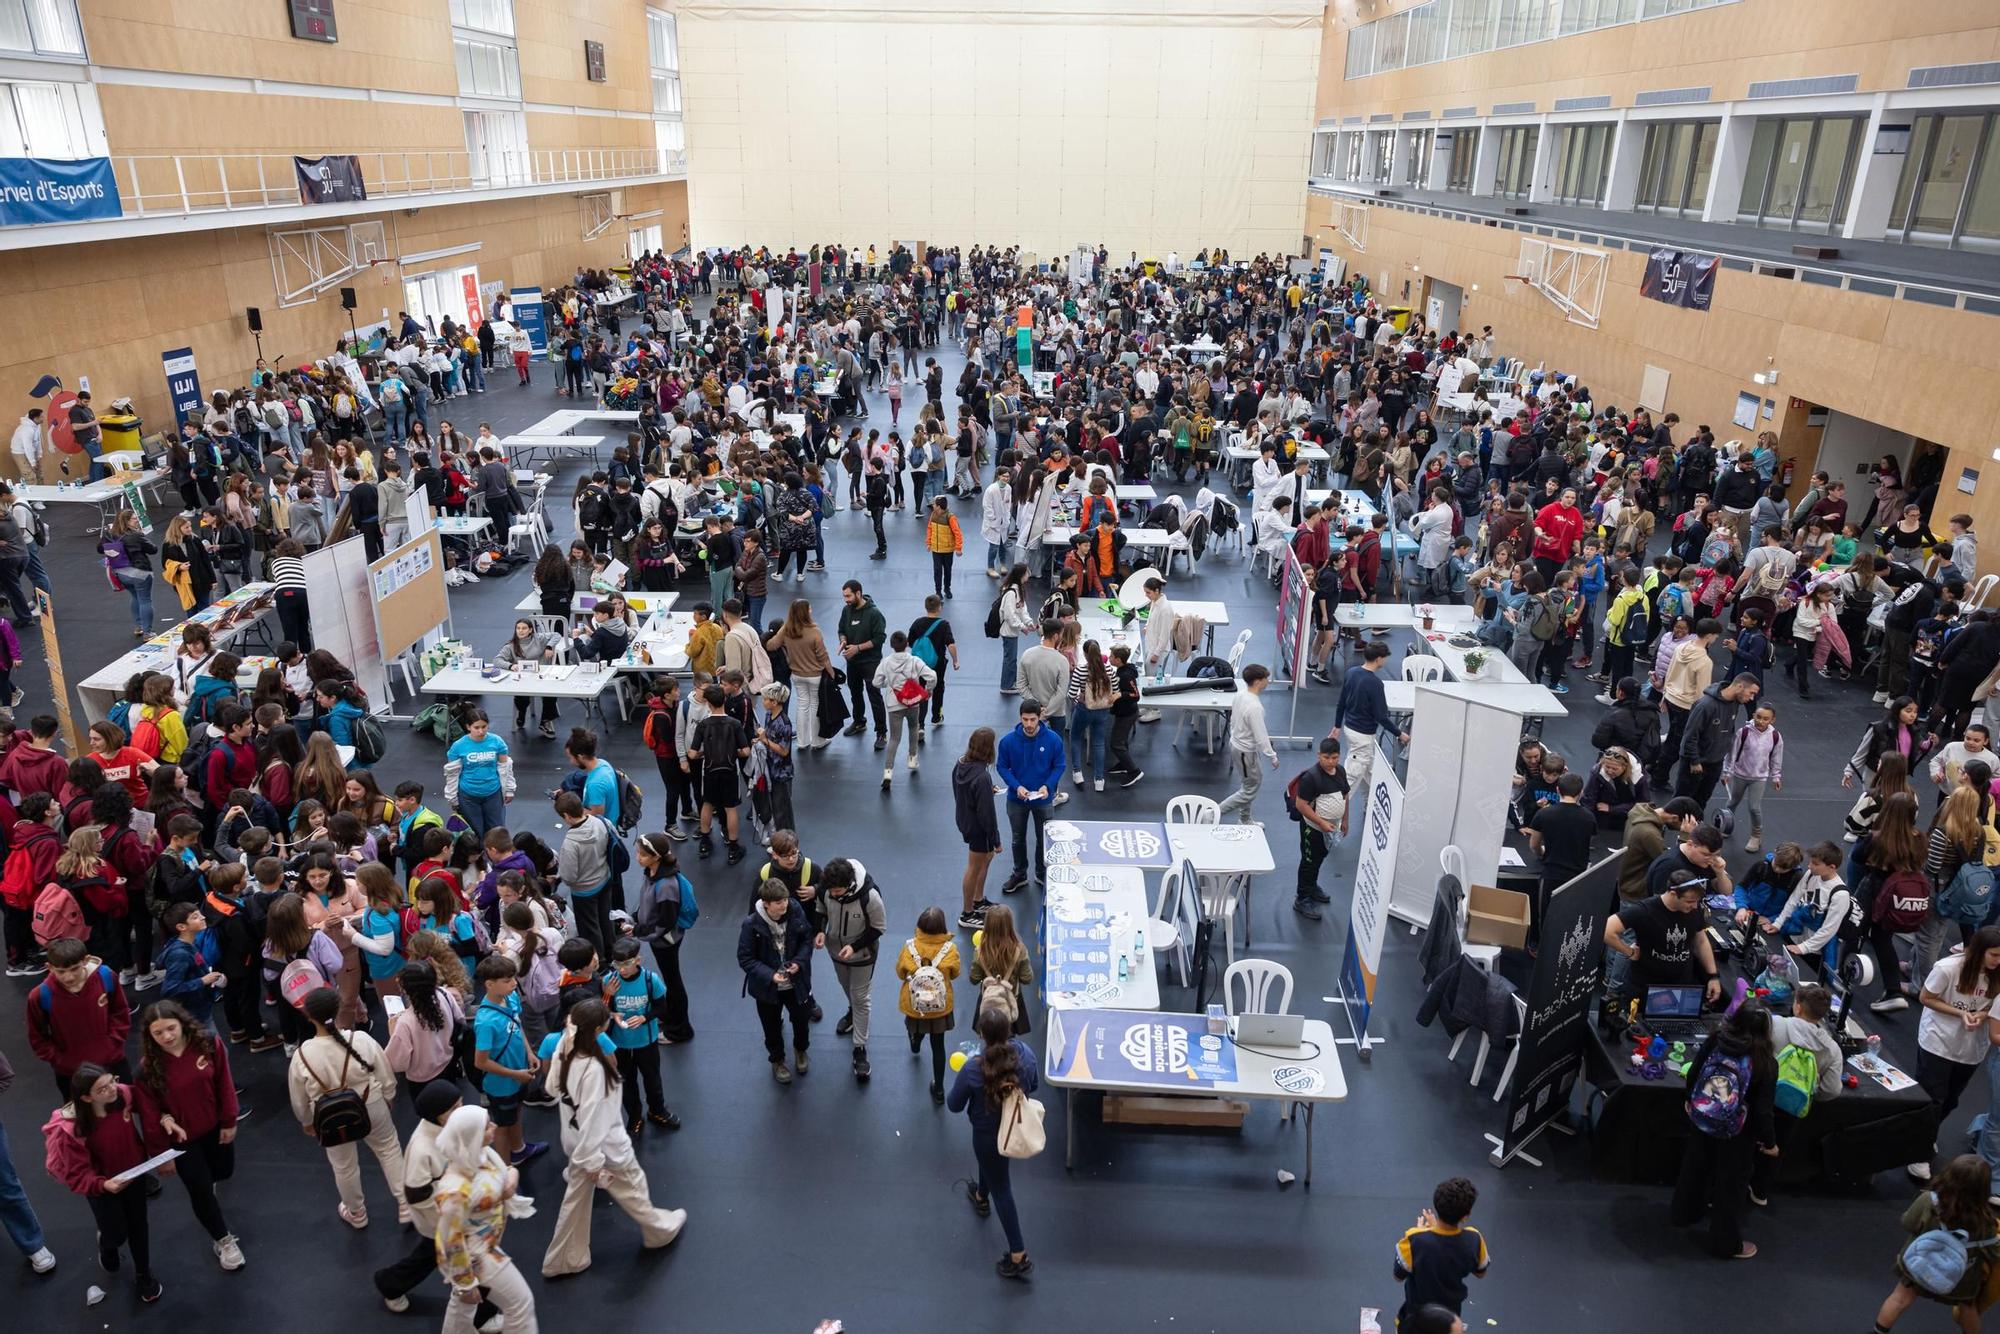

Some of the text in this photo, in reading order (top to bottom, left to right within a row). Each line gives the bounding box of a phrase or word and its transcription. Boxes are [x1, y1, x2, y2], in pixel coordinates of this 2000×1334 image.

[0, 179, 105, 205] ervei d'Esports
[174, 378, 195, 395] UJI
[179, 399, 198, 412] UBE
[1892, 894, 1930, 912] VANS
[1150, 1023, 1169, 1073] sapiència
